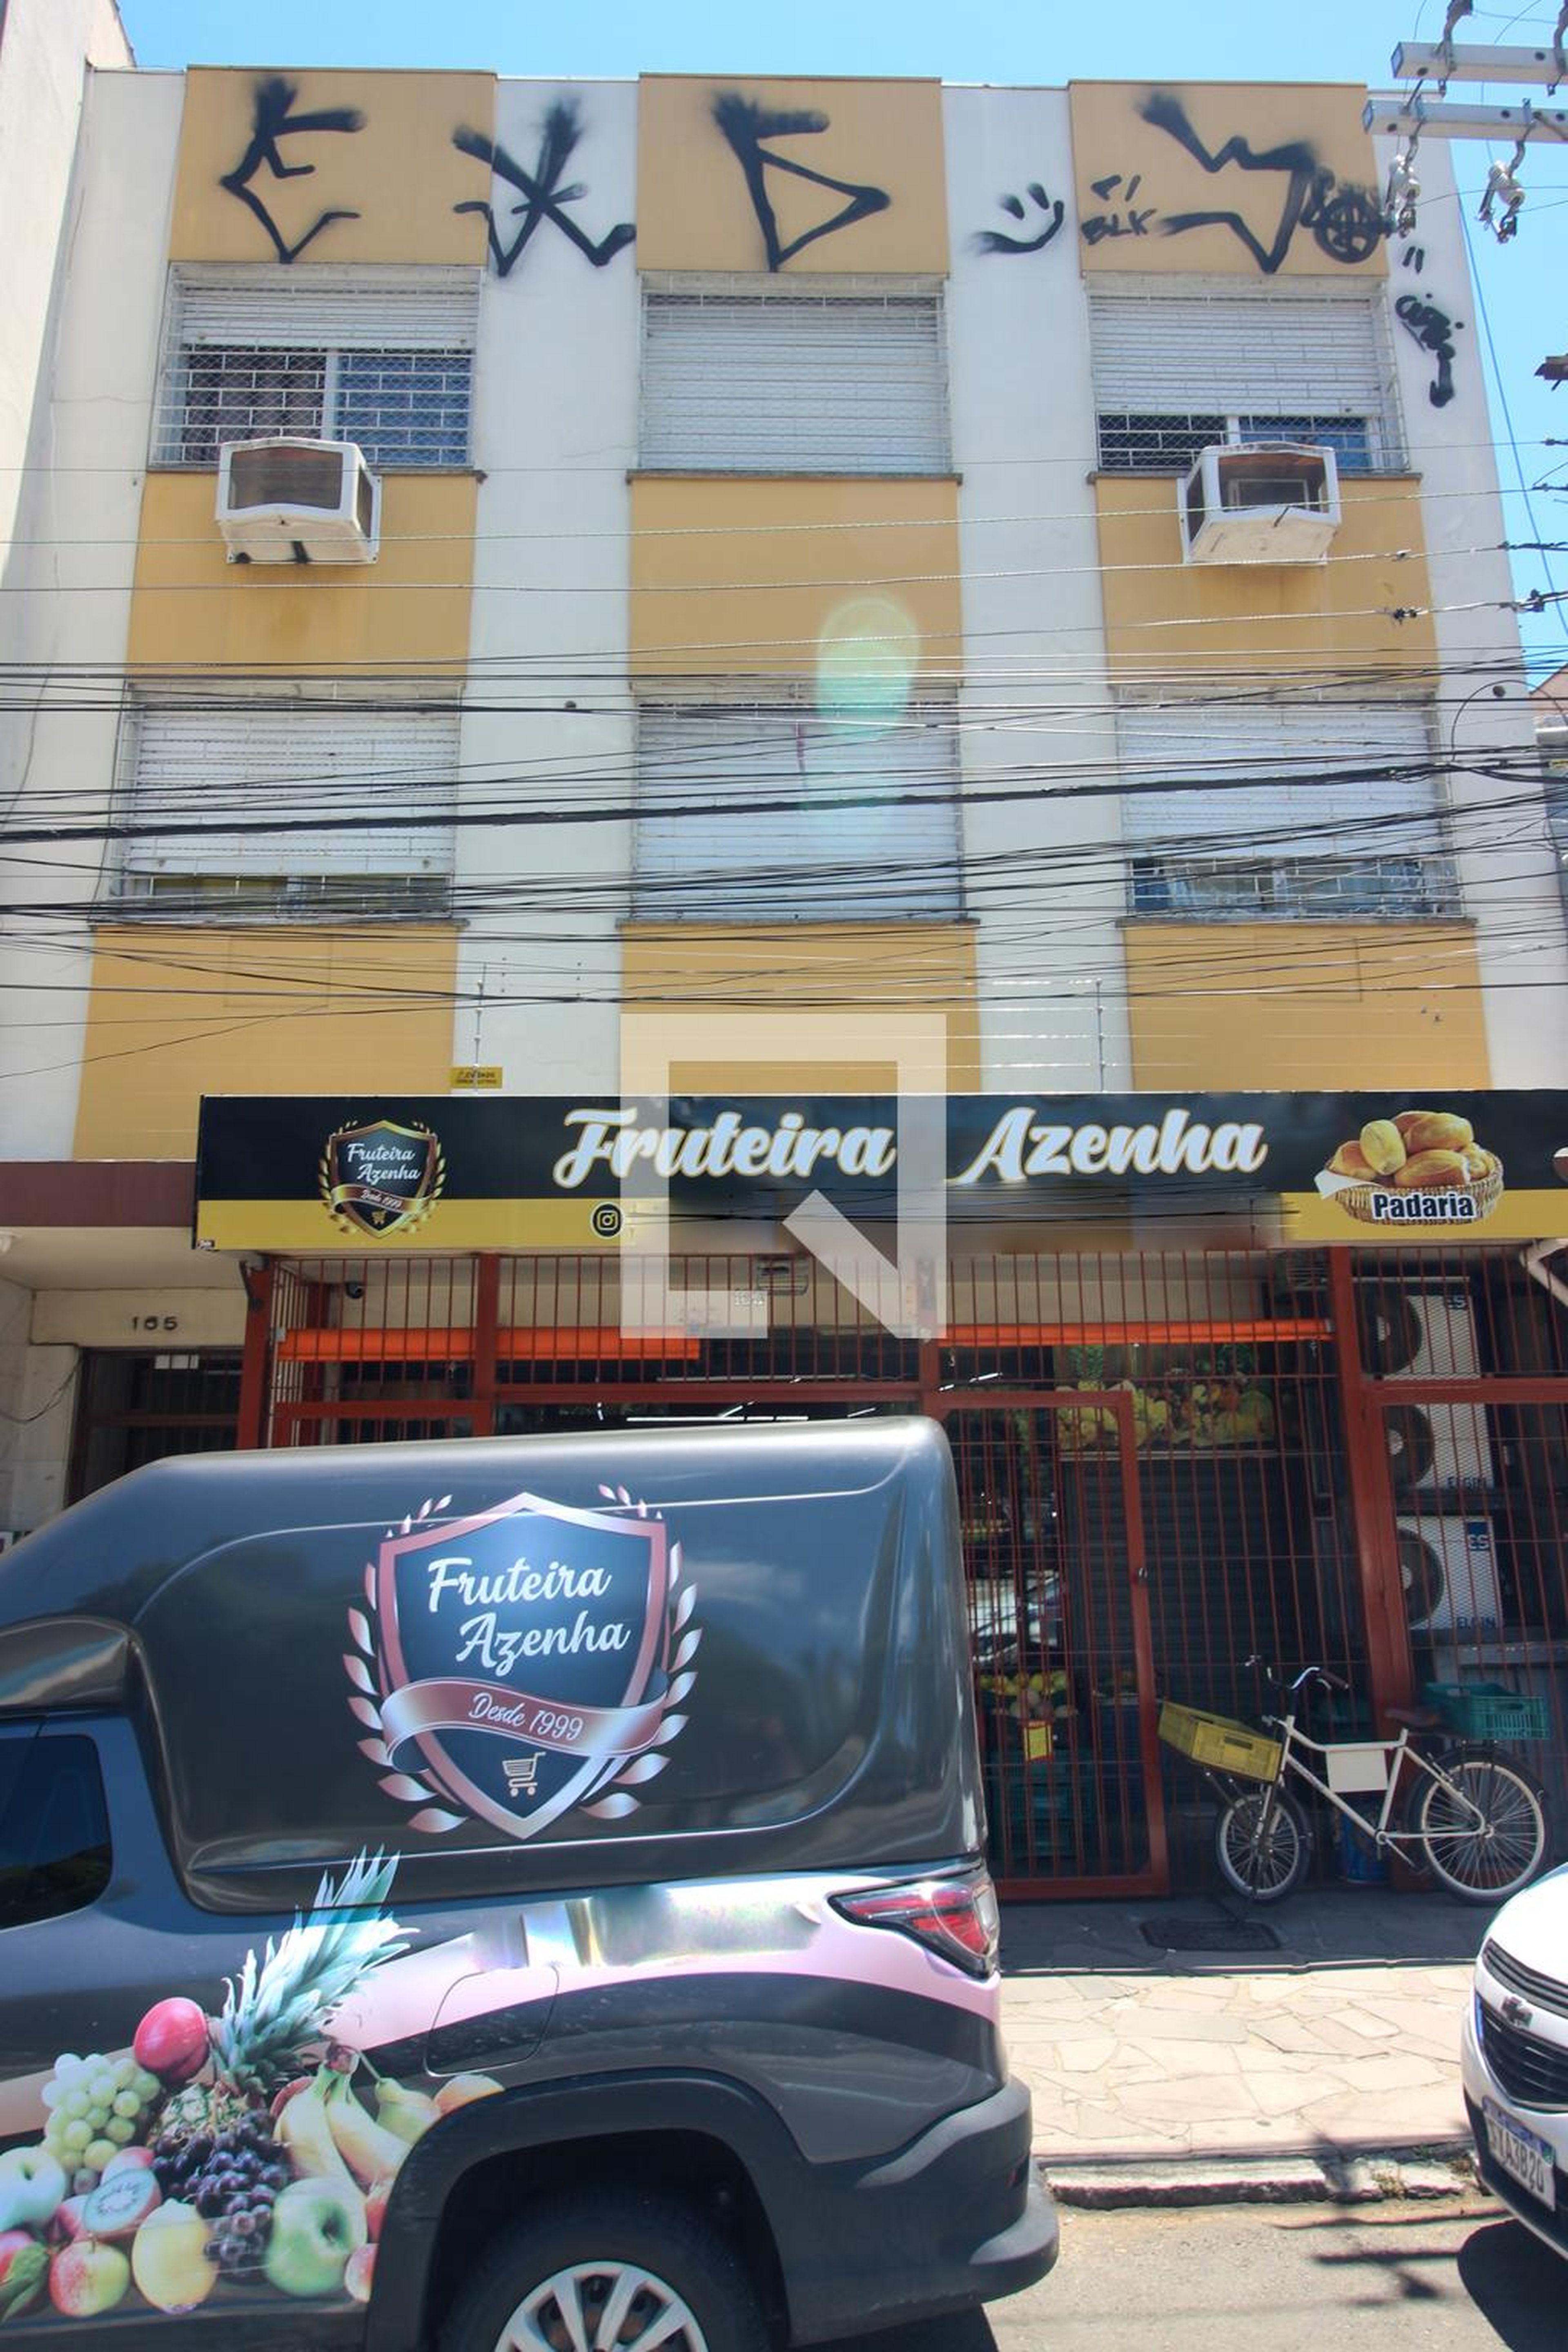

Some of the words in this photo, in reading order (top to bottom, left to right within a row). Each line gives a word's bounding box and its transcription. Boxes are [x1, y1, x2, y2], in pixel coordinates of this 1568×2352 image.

[347, 1143, 415, 1162] Fruteira
[552, 1107, 897, 1189] Fruteira
[943, 1106, 1268, 1184] Azenha
[356, 1163, 422, 1185] Azenha
[1372, 1193, 1475, 1218] Padaria
[428, 1556, 612, 1613] Fruteira
[456, 1610, 631, 1676] Azenha
[468, 1692, 526, 1728] Desde
[528, 1709, 584, 1740] 1999
